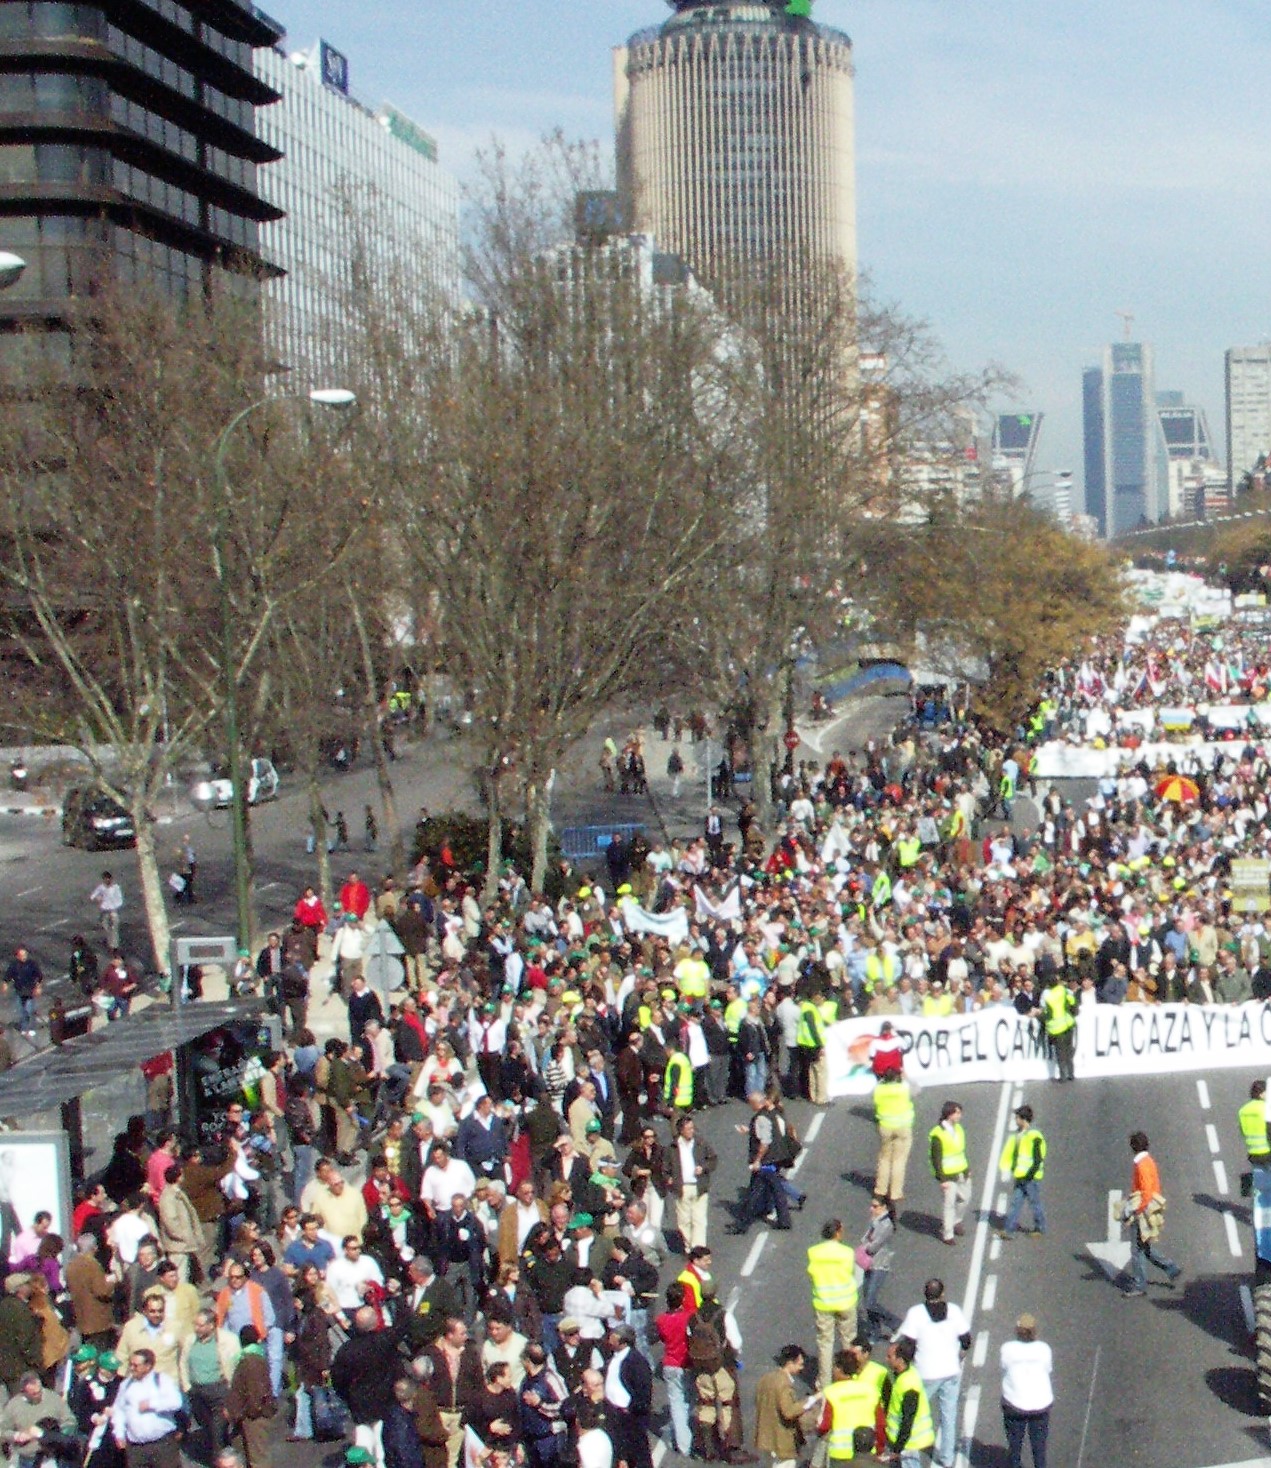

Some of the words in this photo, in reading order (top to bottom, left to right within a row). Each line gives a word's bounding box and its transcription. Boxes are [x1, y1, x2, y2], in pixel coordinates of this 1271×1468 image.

[896, 1030, 952, 1069] POR
[960, 1021, 988, 1063] EL
[1095, 1014, 1122, 1057] LA
[1130, 1011, 1195, 1056] CAZA
[1202, 1010, 1217, 1049] Y
[1224, 1010, 1253, 1049] LA
